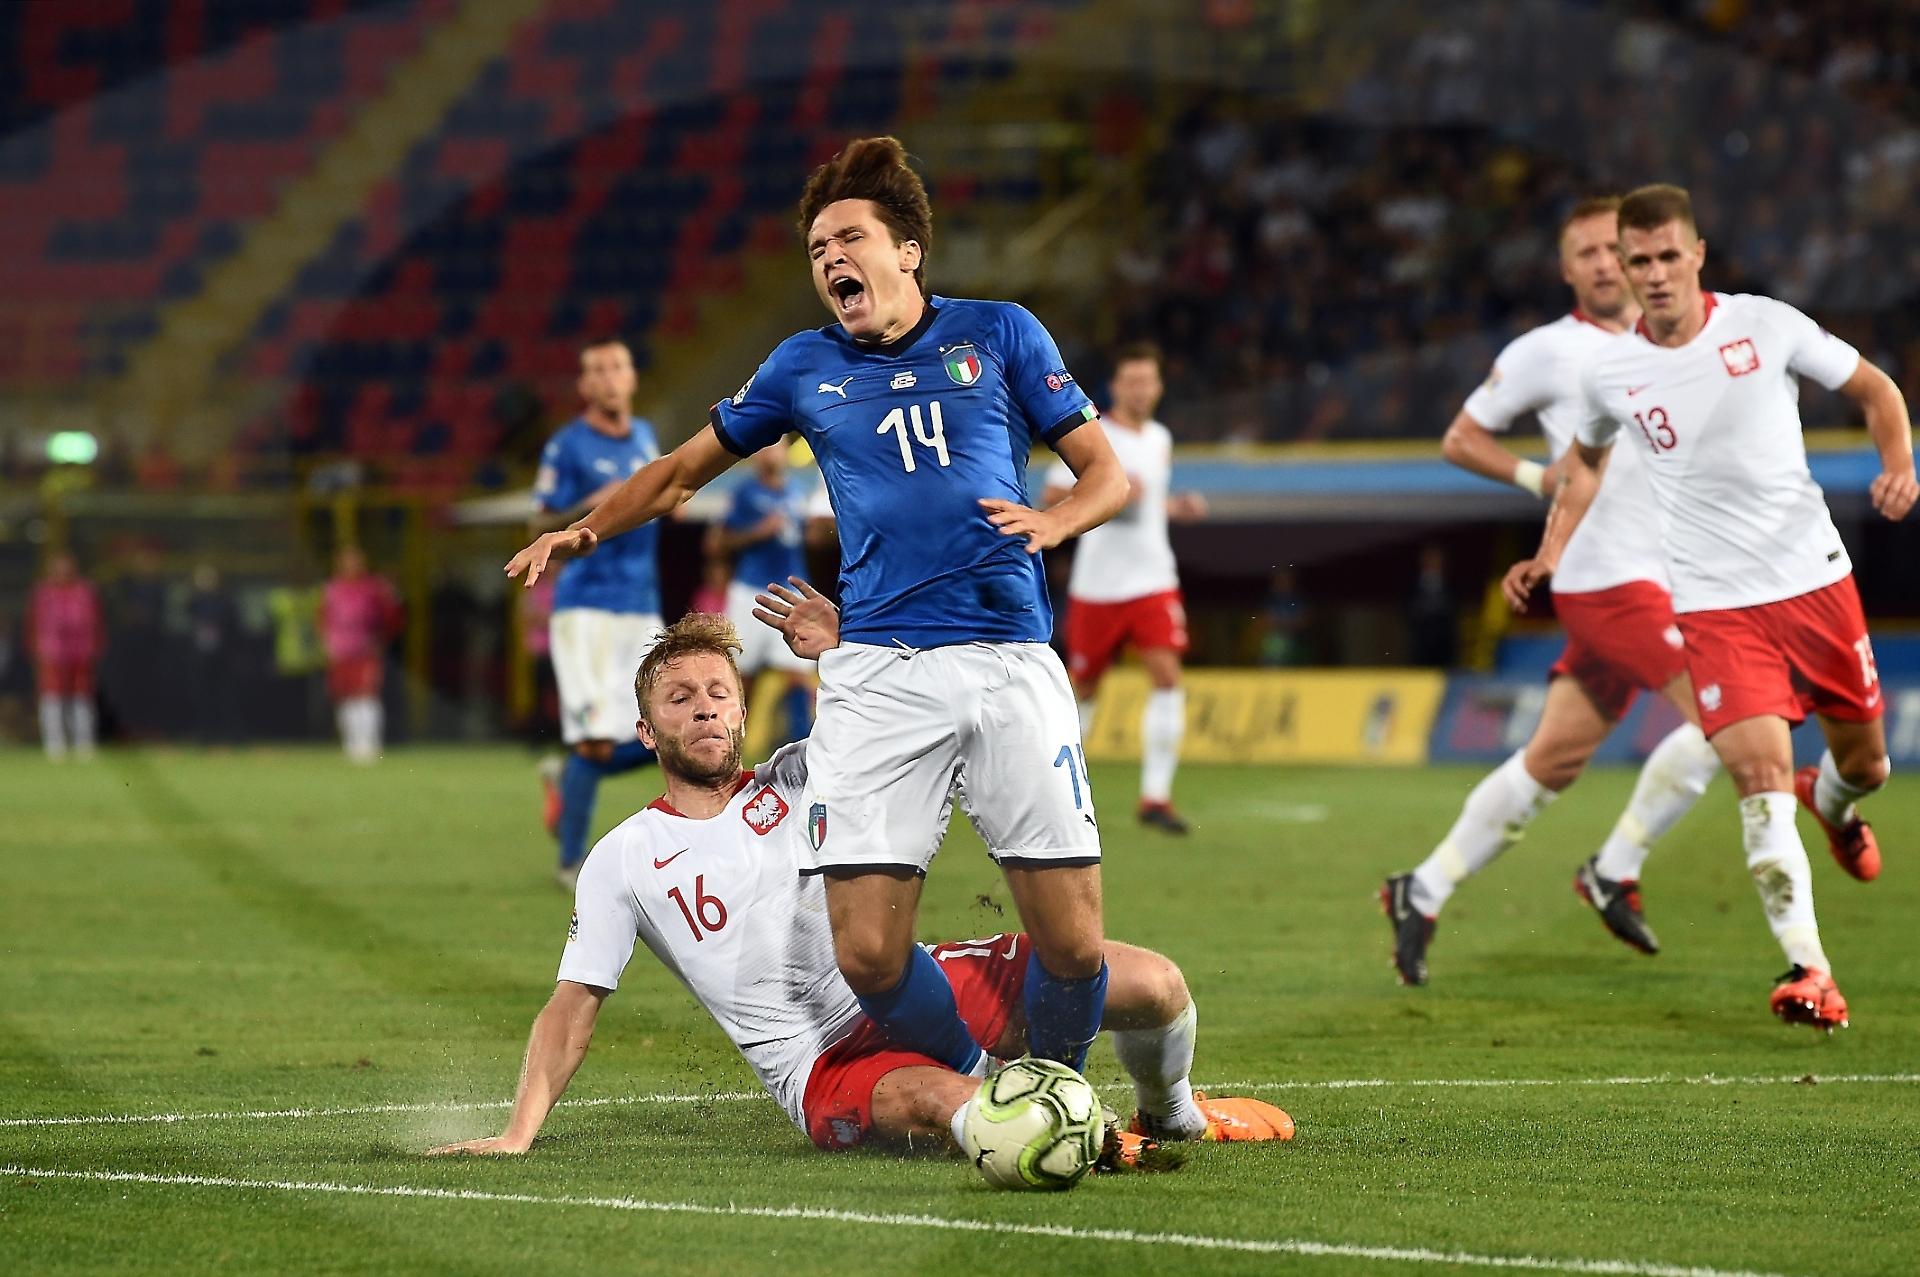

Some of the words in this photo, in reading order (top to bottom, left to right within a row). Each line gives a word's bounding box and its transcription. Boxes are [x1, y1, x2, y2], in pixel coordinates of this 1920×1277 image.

[876, 400, 951, 473] 14
[1633, 406, 1677, 455] 13
[667, 874, 728, 943] 16
